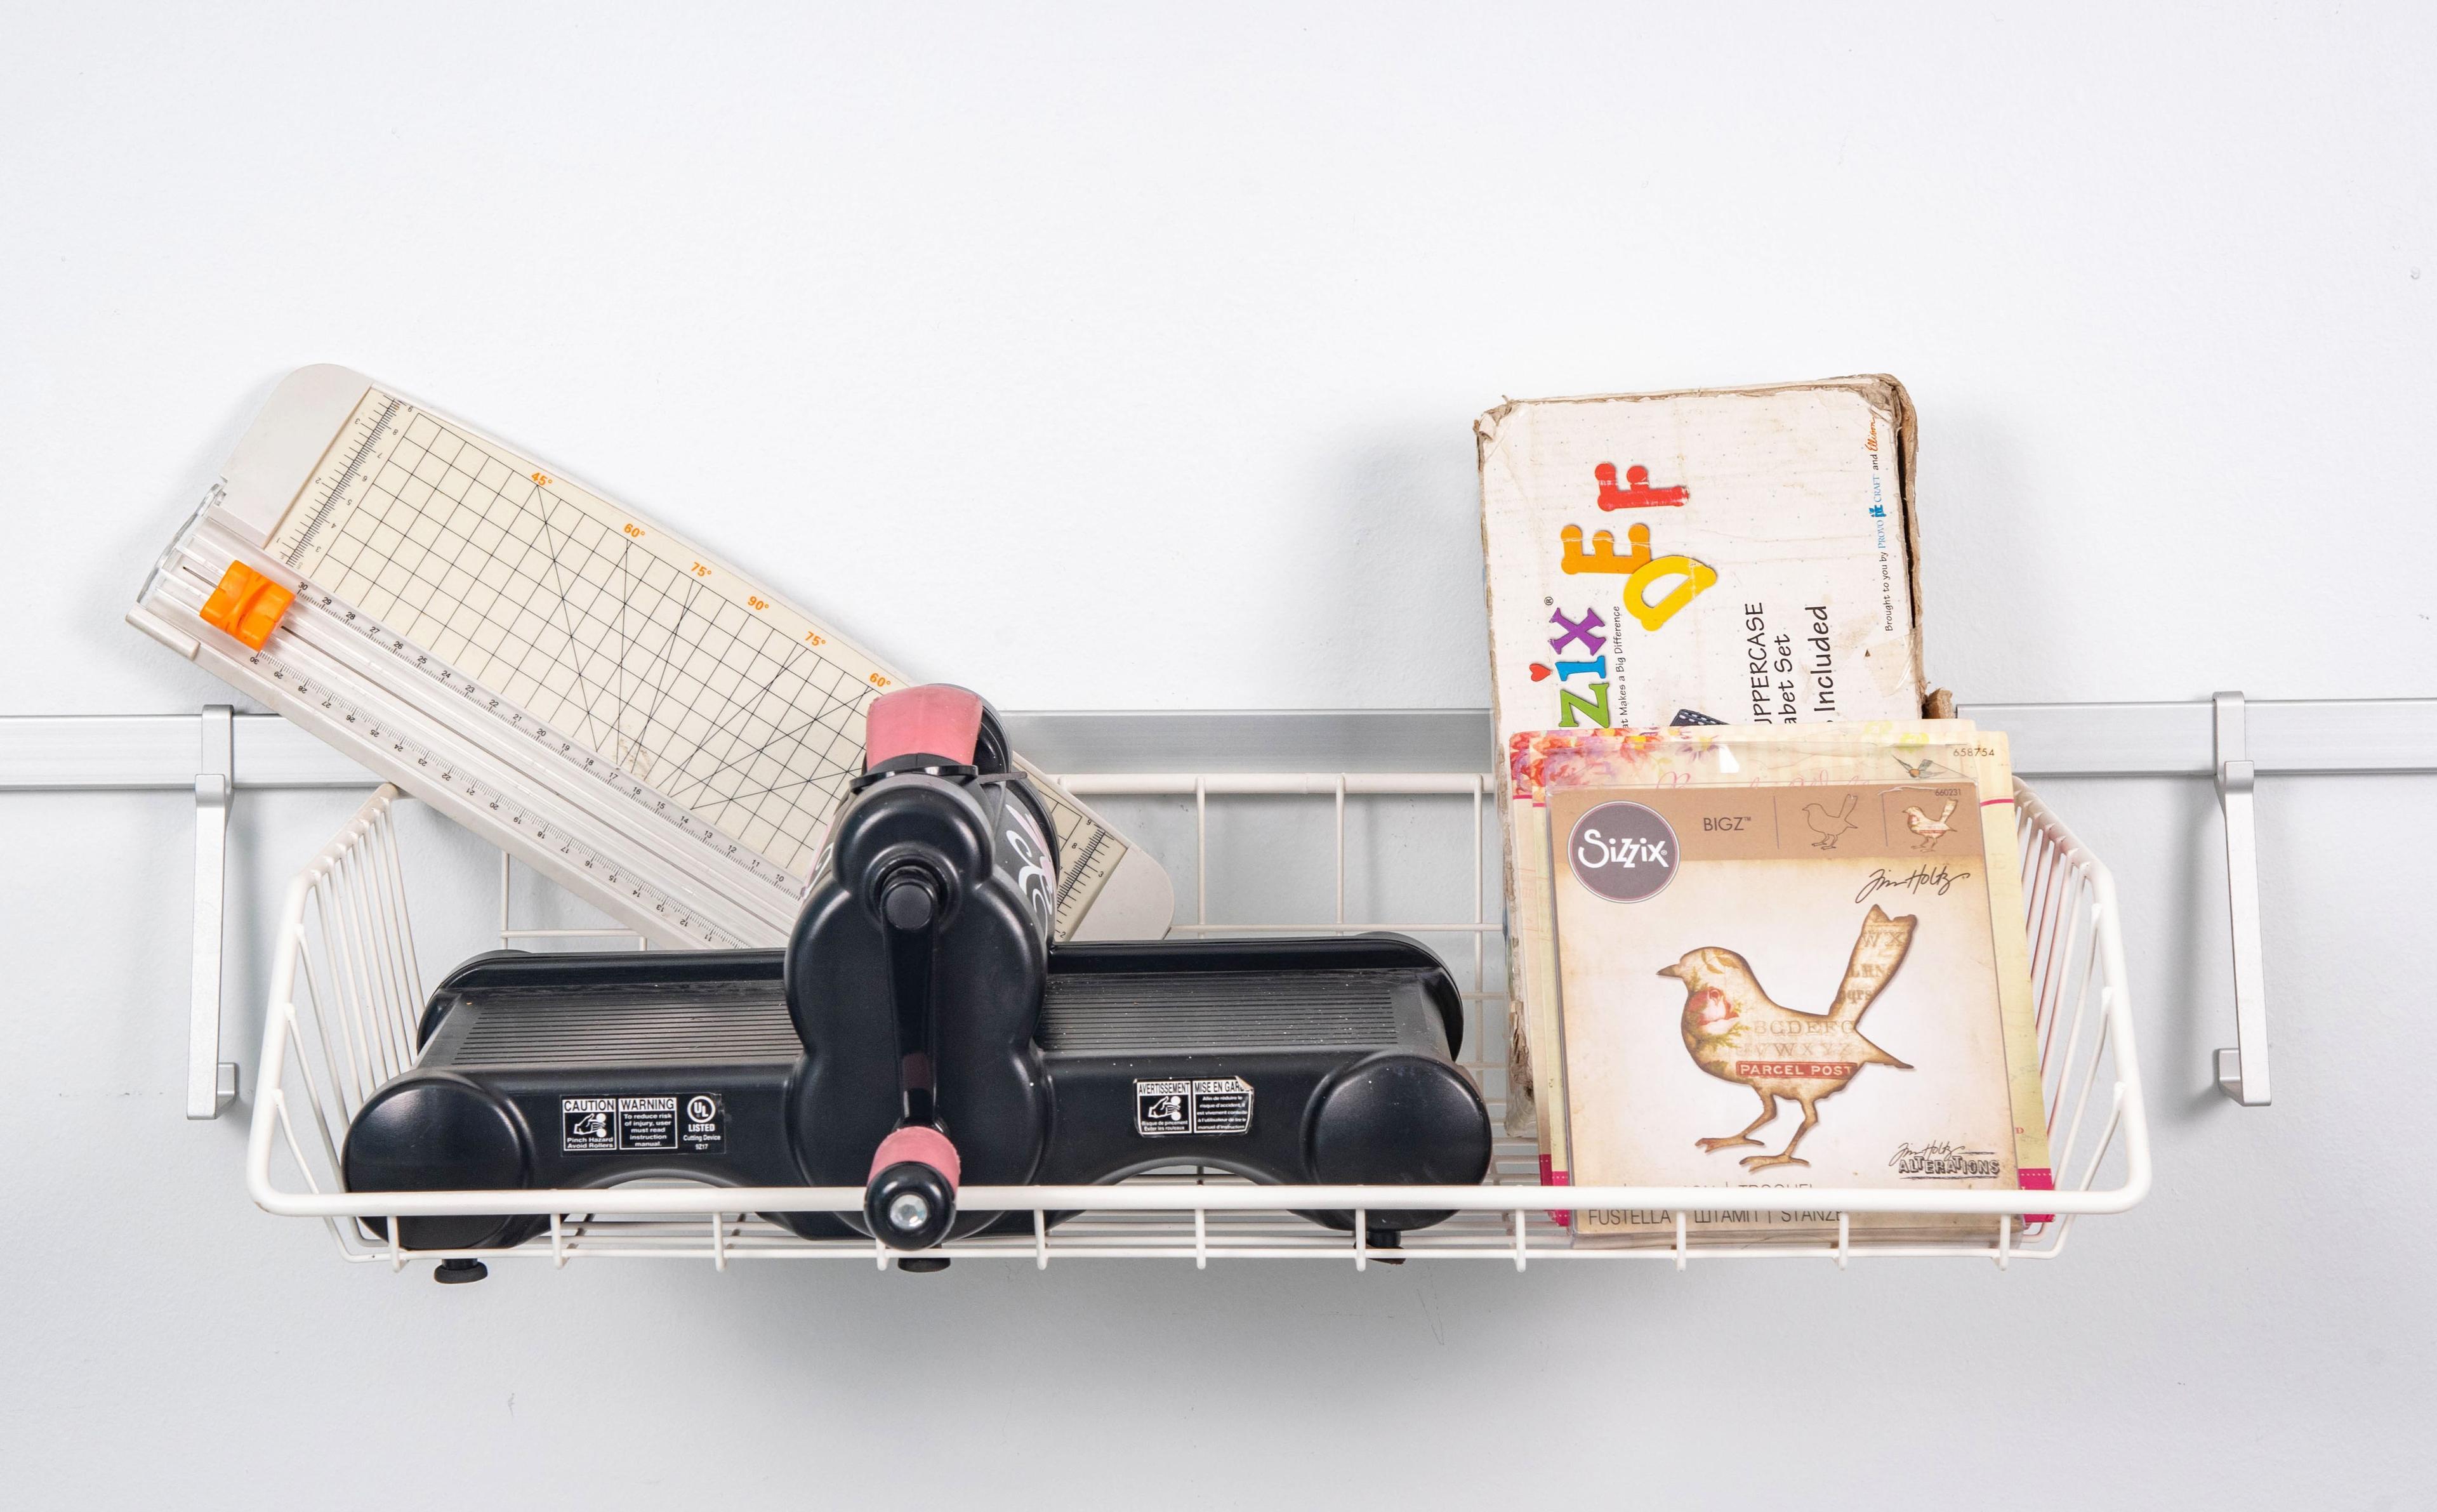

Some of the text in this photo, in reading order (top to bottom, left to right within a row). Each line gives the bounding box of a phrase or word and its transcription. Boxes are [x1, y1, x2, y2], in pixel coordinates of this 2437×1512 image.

[1870, 453, 1879, 470] and
[531, 471, 553, 486] 45°
[624, 523, 645, 539] 60°
[1877, 520, 1886, 549] PROVO
[1879, 551, 1889, 564] by
[690, 562, 712, 577] 75°
[1882, 565, 1891, 582] you
[1882, 582, 1889, 593] to
[748, 596, 769, 611] 90°
[1882, 596, 1892, 631] Brought
[1613, 606, 1623, 654] Difference
[805, 631, 826, 647] 75°
[1774, 634, 1793, 673] Set
[1805, 606, 1835, 711] Included
[1616, 657, 1626, 673] Big
[869, 672, 891, 688] 60°
[1618, 683, 1629, 715] Makes
[298, 581, 308, 591] 30
[321, 596, 333, 605] 29
[345, 611, 356, 620] 28
[369, 626, 381, 634] 27
[393, 641, 404, 650] 26
[417, 655, 428, 664] 25
[441, 670, 451, 678] 24
[465, 685, 475, 694] 23
[489, 699, 499, 707] 22
[512, 713, 522, 722] 21
[536, 728, 547, 737] 20
[562, 743, 571, 751] 19
[585, 758, 595, 766] 18
[633, 787, 642, 795] 16
[656, 801, 666, 810] 15
[680, 815, 689, 824] 14
[704, 830, 713, 839] 13
[728, 845, 737, 853] 12
[751, 859, 760, 867] 11
[776, 873, 784, 882] 10
[1953, 747, 1995, 758] 658754
[249, 656, 260, 665] 30
[274, 671, 284, 680] 29
[298, 685, 308, 694] 28
[321, 700, 332, 709] 27
[345, 714, 356, 723] 26
[369, 729, 380, 738] 25
[393, 744, 404, 753] 24
[418, 758, 428, 767] 23
[441, 773, 451, 782] 22
[466, 787, 475, 796] 21
[489, 802, 499, 810] 20
[513, 817, 522, 825] 19
[537, 831, 545, 839] 18
[584, 860, 593, 869] 16
[609, 874, 617, 883] 15
[632, 889, 641, 898] 14
[656, 904, 664, 912] 13
[680, 918, 689, 927] 12
[703, 933, 711, 942] 11
[1934, 788, 1962, 797] 660231
[1740, 1064, 1853, 1076] PARCEL POST
[1139, 1082, 1190, 1095] AVERTISSEMENT
[1194, 1082, 1212, 1093] MISE
[1213, 1082, 1223, 1092] EN
[564, 1101, 614, 1111] CAUTION
[621, 1099, 674, 1110] WARNING
[688, 1124, 715, 1132] LISTED
[1898, 1156, 2001, 1175] ALTERATIONS
[1588, 1209, 1671, 1225] FUSTELLA
